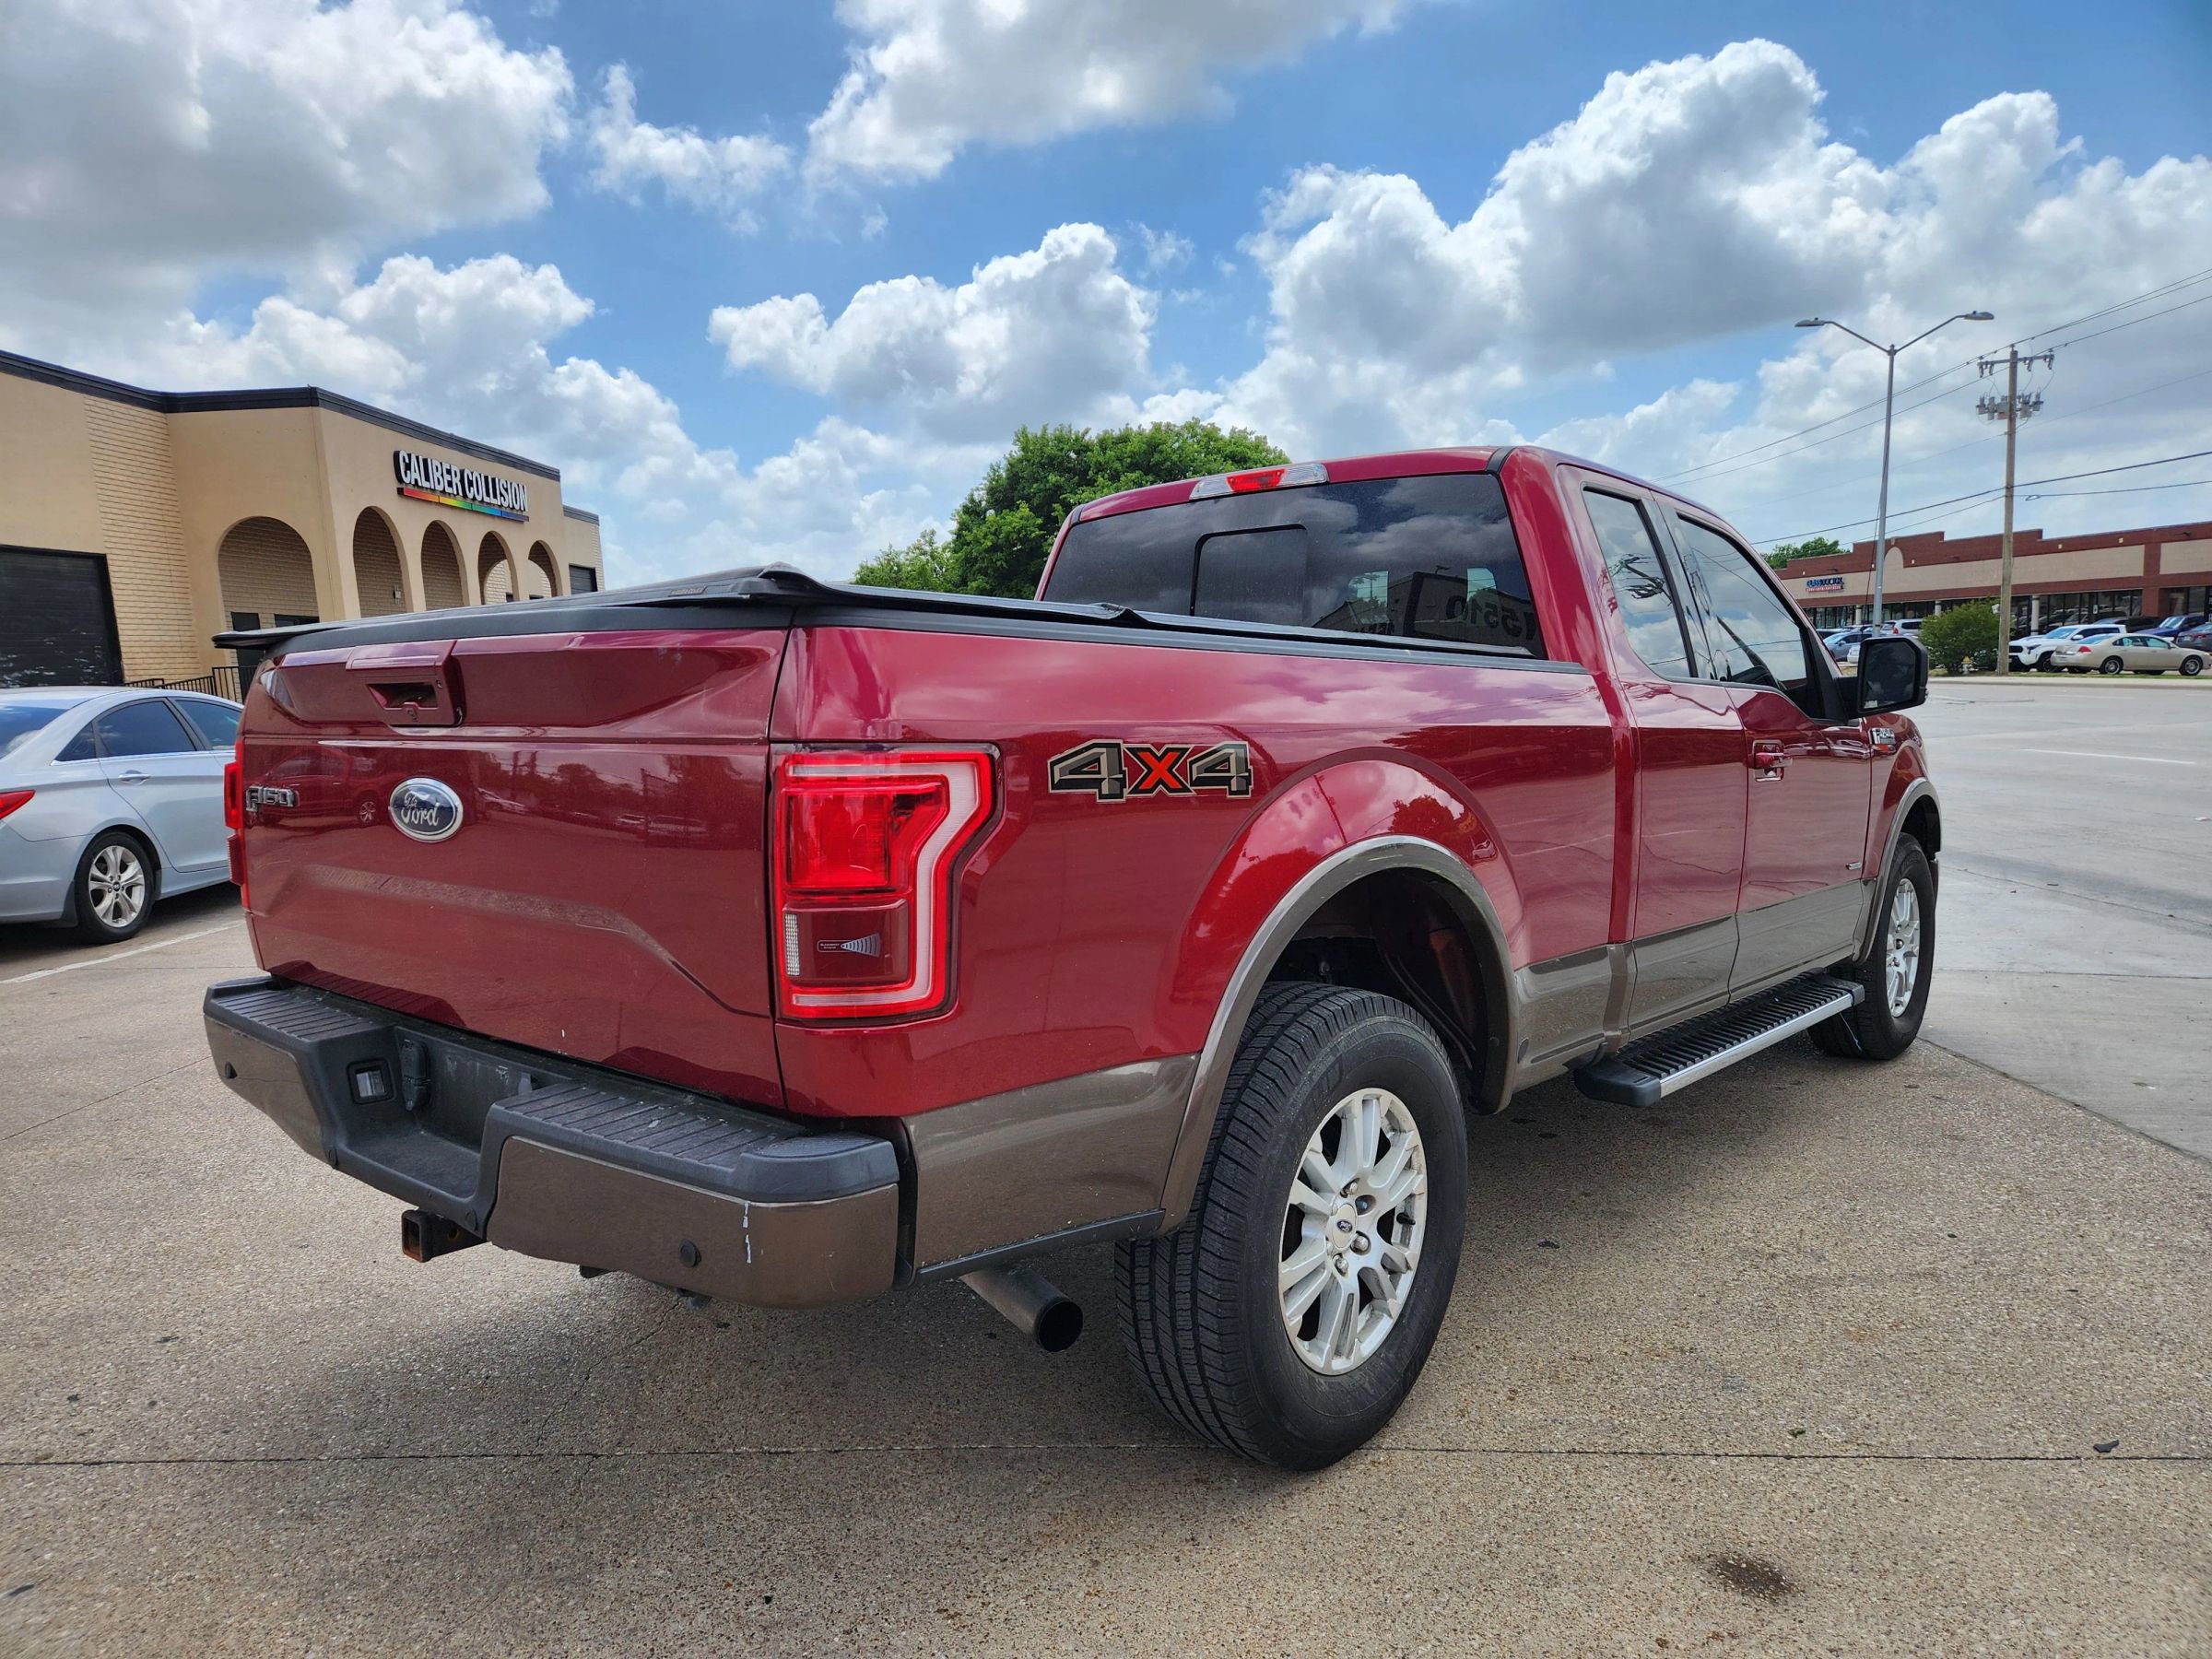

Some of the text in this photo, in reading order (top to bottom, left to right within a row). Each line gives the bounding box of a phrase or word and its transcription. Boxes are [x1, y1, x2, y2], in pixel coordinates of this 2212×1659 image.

[398, 450, 528, 512] CALIBER COLLISION
[400, 790, 441, 827] Ford
